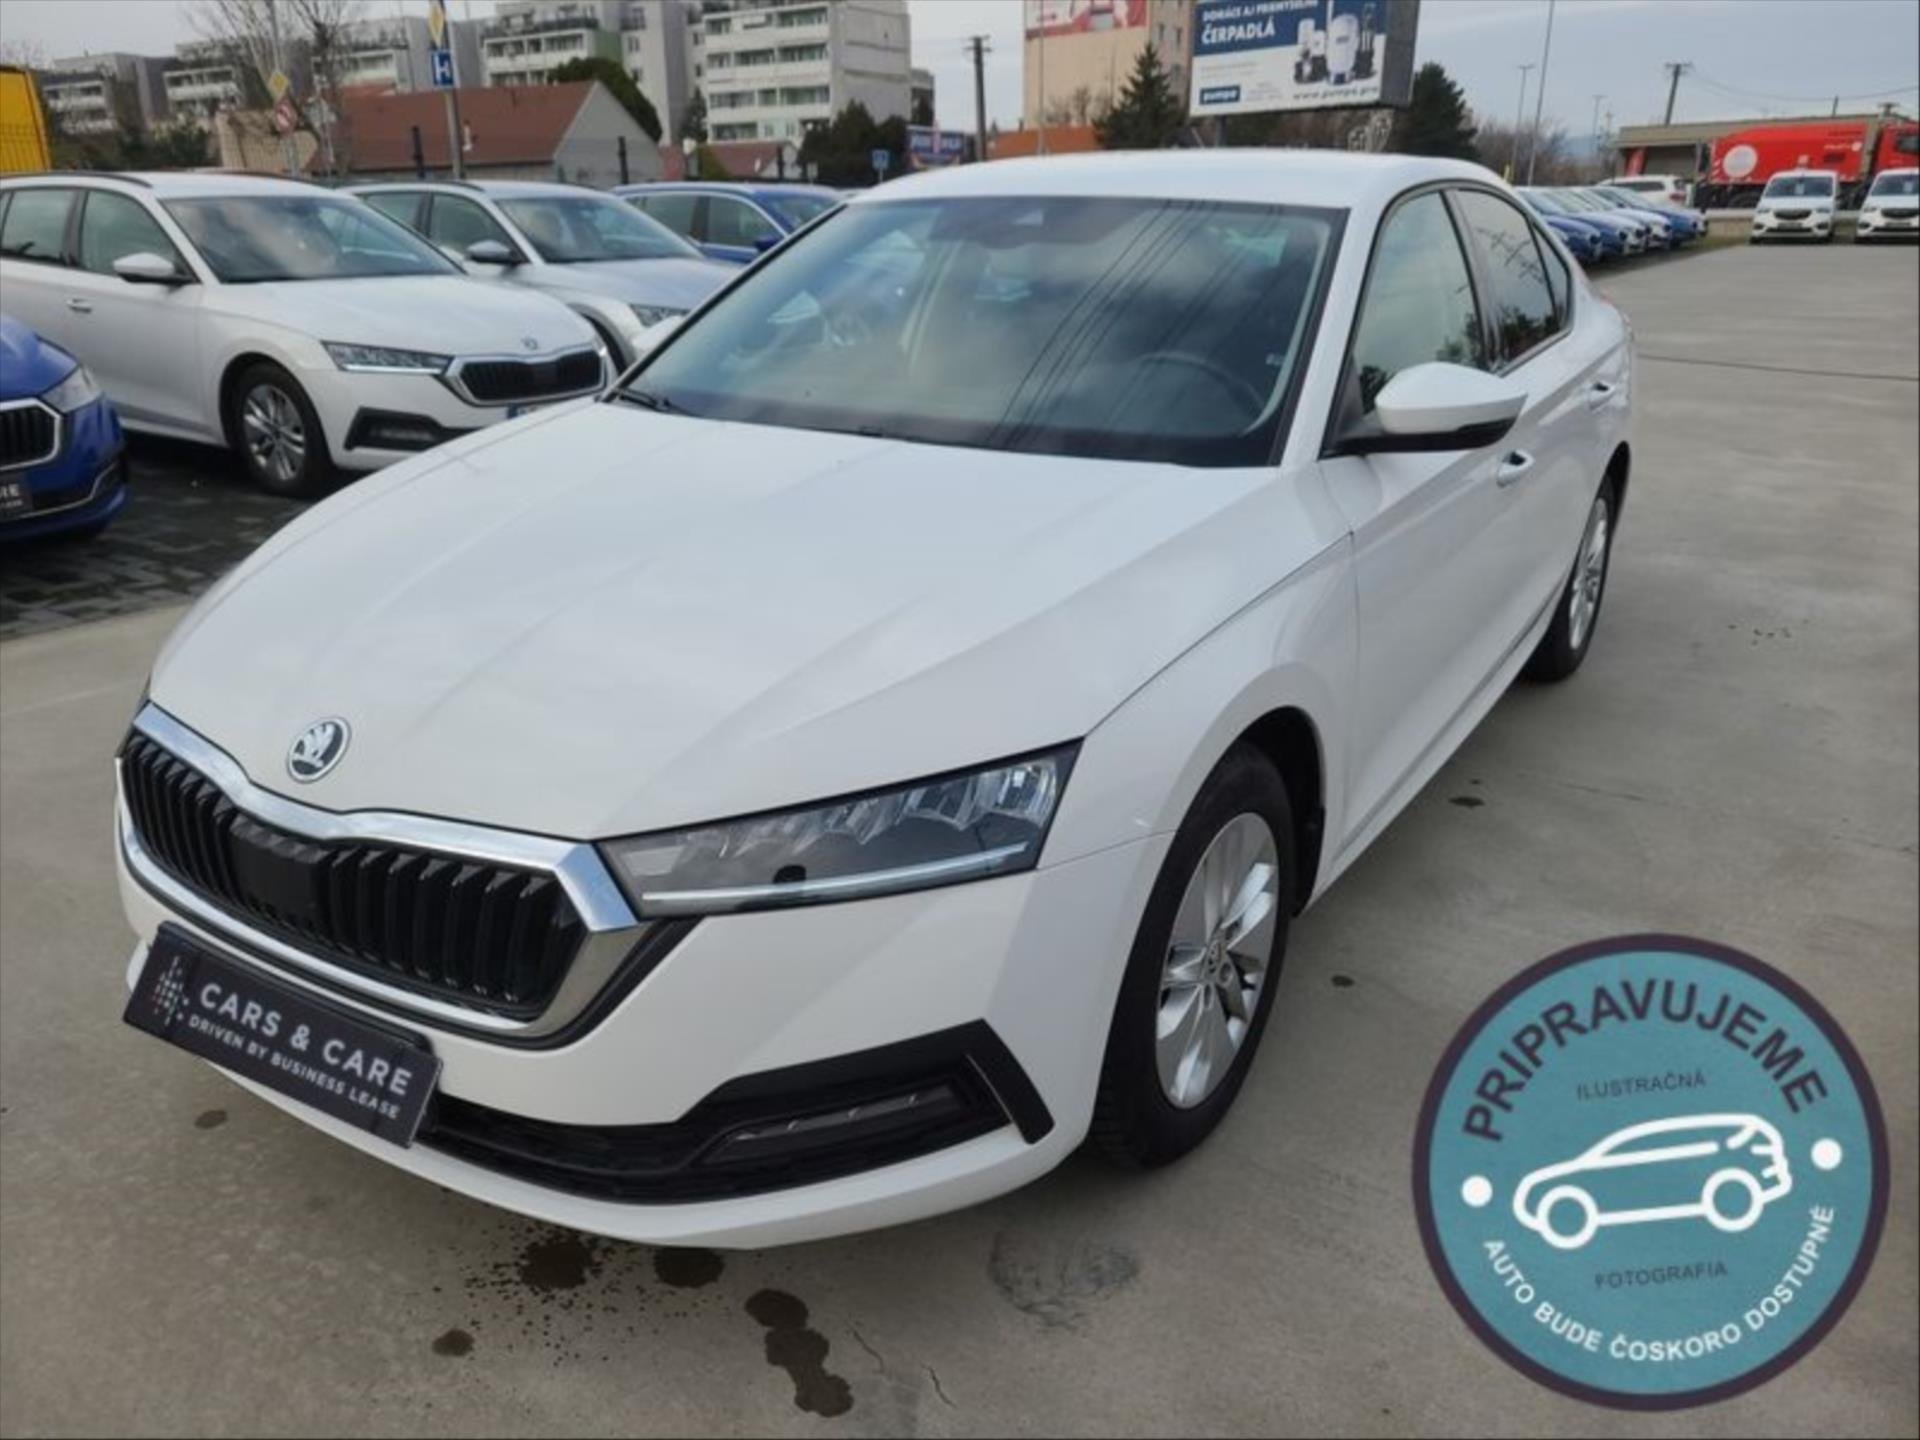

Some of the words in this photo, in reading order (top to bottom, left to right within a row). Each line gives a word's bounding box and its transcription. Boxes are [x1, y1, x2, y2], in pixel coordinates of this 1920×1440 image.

[1201, 16, 1275, 44] ČERPADLÁ
[188, 1014, 245, 1049] DRIVEN
[246, 1041, 269, 1060] BY
[270, 1053, 346, 1095] BUSINESS
[349, 1086, 400, 1120] LEASE
[200, 983, 282, 1038] CARS
[290, 1024, 311, 1052] &
[323, 1040, 413, 1096] CARE
